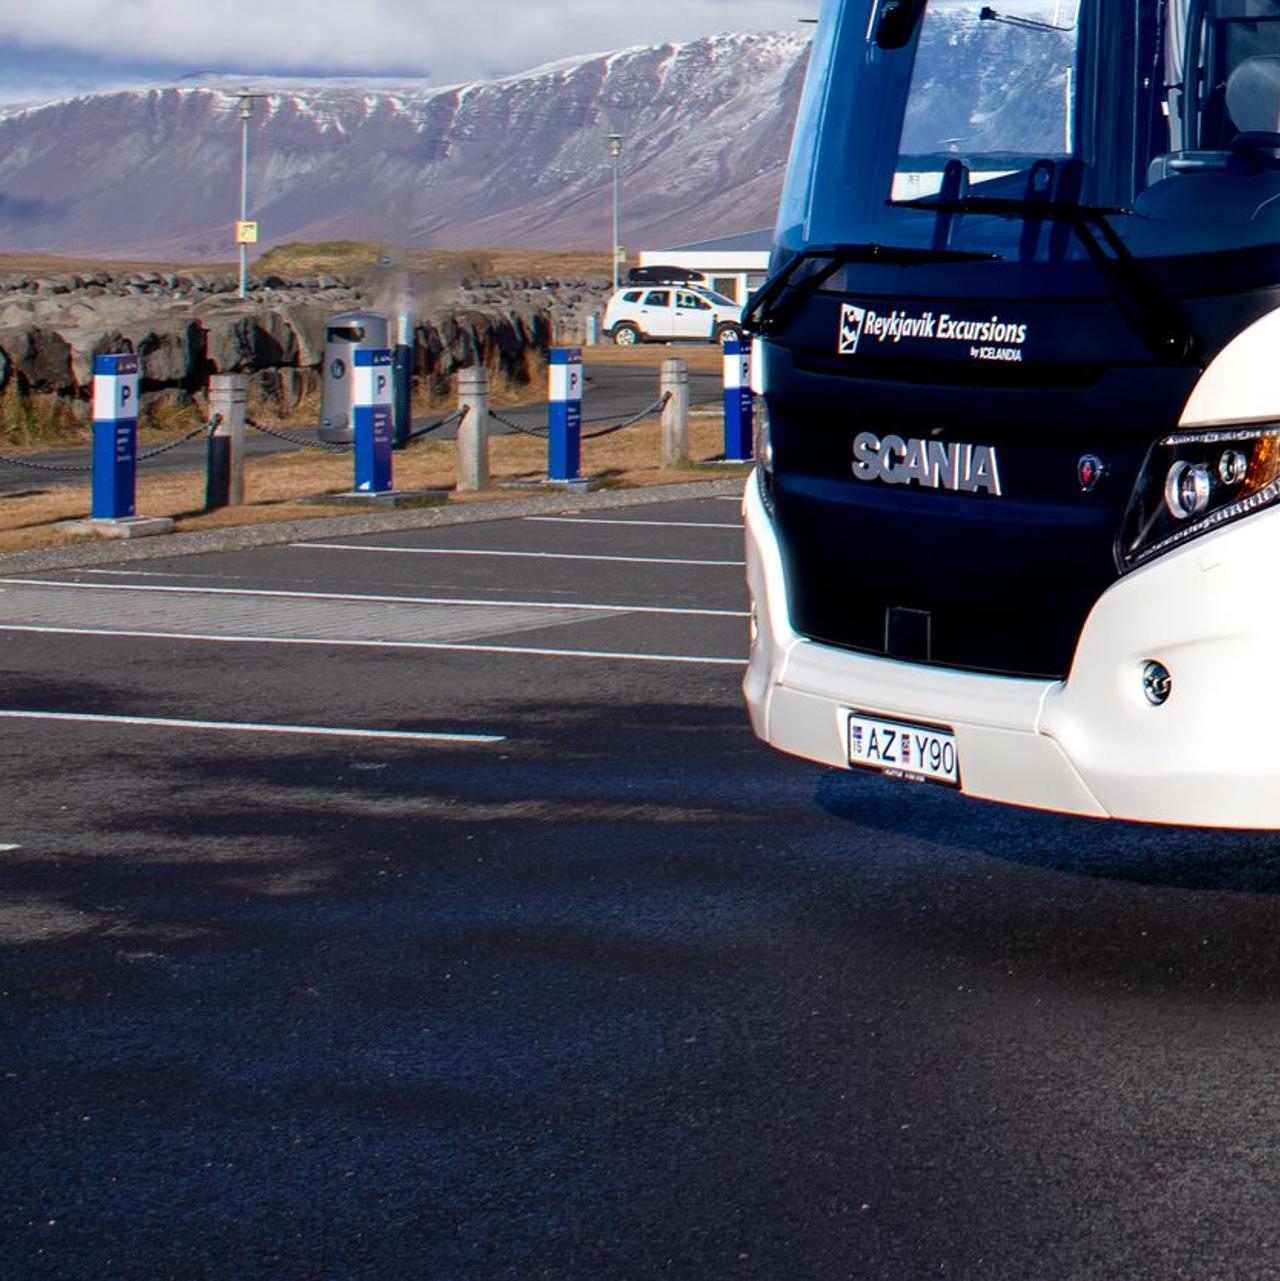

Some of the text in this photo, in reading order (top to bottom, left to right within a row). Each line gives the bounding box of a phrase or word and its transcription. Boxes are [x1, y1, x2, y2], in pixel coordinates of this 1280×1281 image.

[864, 310, 1028, 344] Reykjavik Excursions
[969, 346, 1022, 362] by ICELANDIA
[121, 385, 131, 407] P
[377, 375, 386, 395] P
[851, 431, 1002, 497] SCANIA
[867, 727, 896, 762] AZ
[915, 735, 954, 774] Y90
